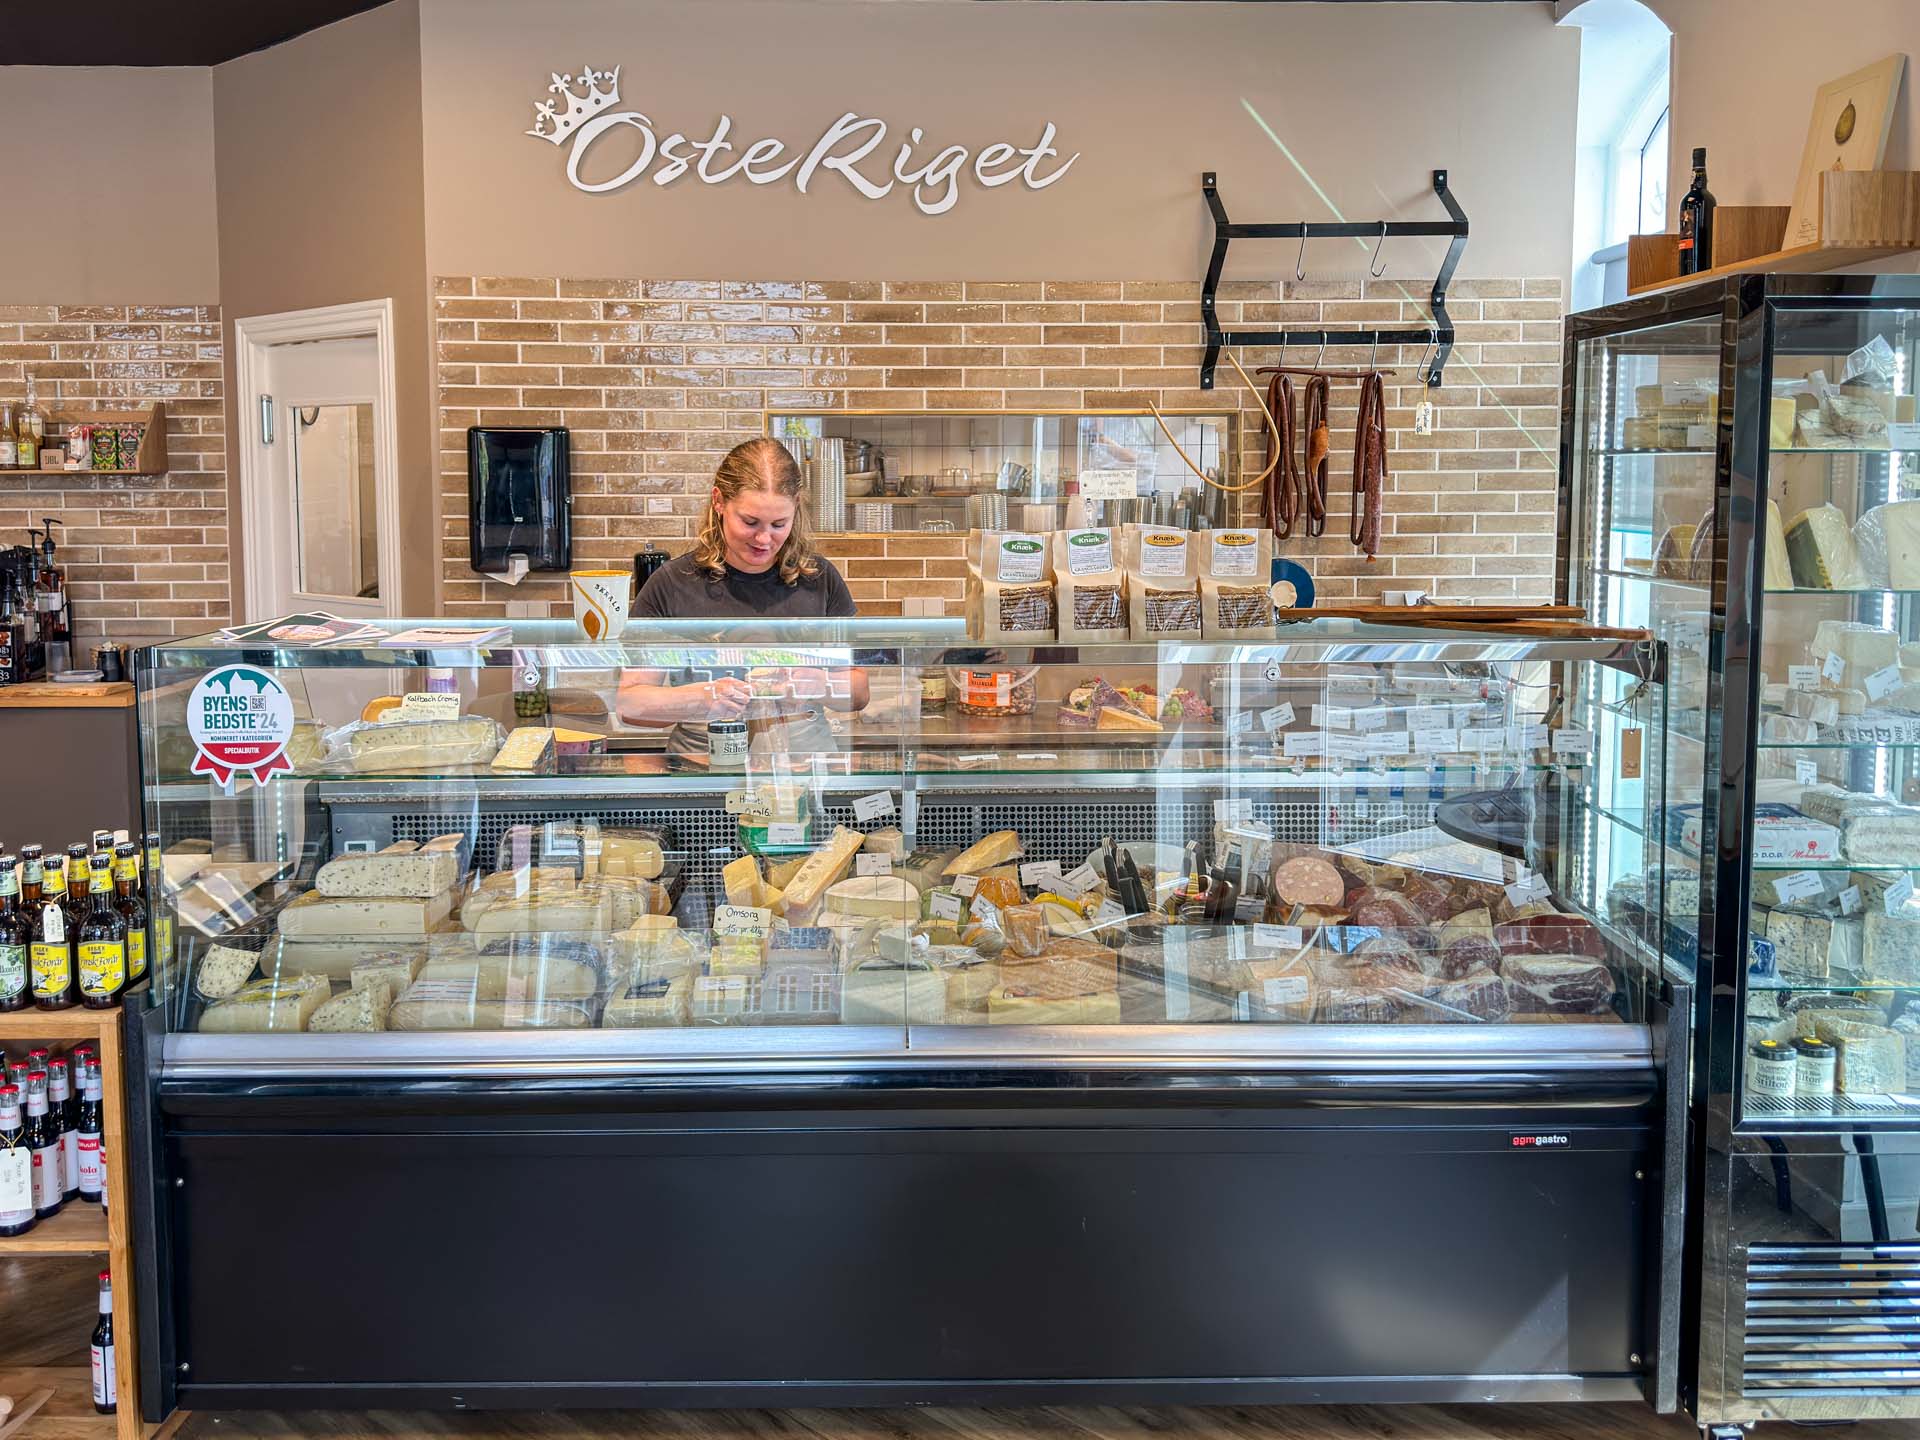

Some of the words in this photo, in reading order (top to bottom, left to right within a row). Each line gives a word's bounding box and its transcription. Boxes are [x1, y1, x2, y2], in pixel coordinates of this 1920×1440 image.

[44, 455, 59, 464] JBL
[1078, 536, 1100, 544] Knæk
[203, 695, 248, 712] BYENS
[224, 747, 260, 755] SPECIALBUTIK
[726, 907, 759, 922] Omsorg
[1755, 1076, 1789, 1089] Stilton
[1512, 1134, 1568, 1146] ggmgastro
